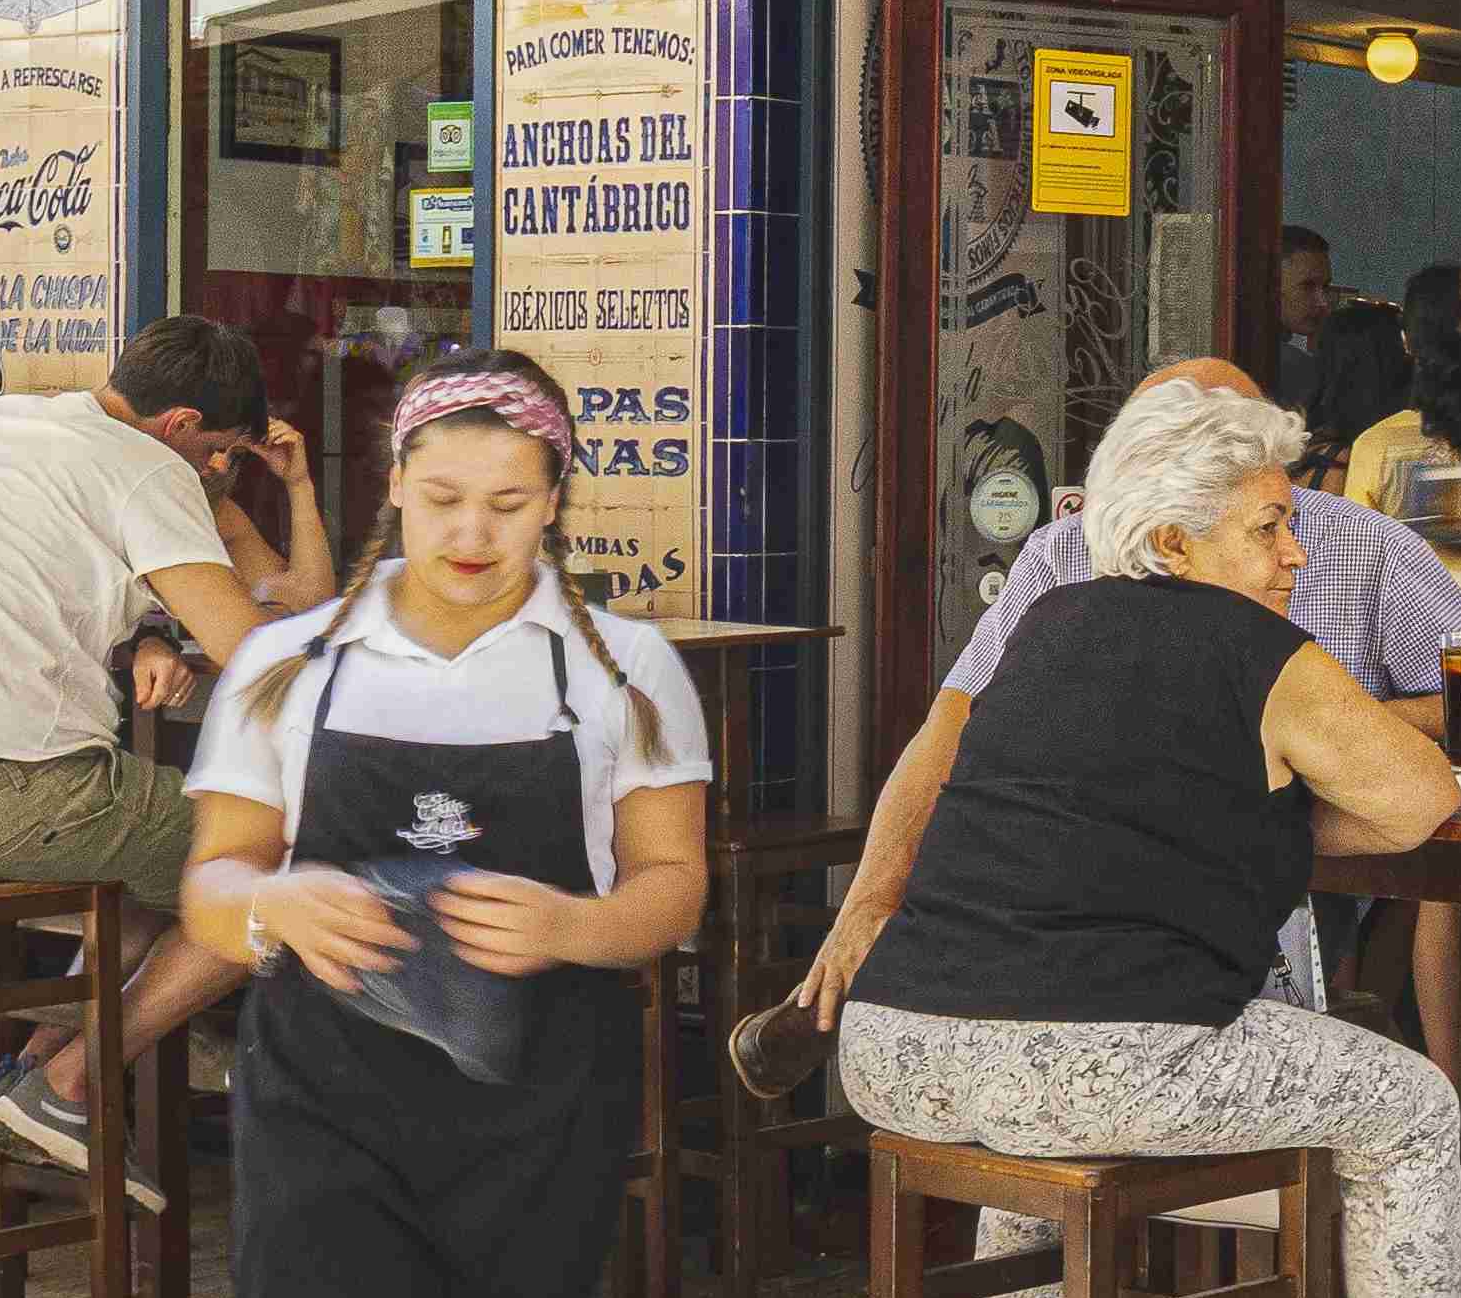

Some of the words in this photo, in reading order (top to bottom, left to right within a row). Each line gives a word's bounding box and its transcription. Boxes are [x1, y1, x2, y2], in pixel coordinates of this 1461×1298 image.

[506, 37, 548, 76] PARA
[549, 28, 605, 62] COMER
[611, 26, 696, 66] TENEMOS:
[1, 69, 11, 91] A
[13, 67, 104, 99] REFRESCARSE
[502, 117, 630, 168] ANCHOAS
[640, 113, 693, 163] DEL
[502, 175, 692, 237] CANTÁBRICO
[31, 273, 107, 311] CHISPA
[503, 283, 589, 333] IBÉRICOS
[595, 287, 691, 331] SELECTOS
[23, 317, 52, 353] LA
[56, 317, 107, 353] VIDA
[570, 385, 692, 424] PAS
[609, 547, 687, 600] DAS
